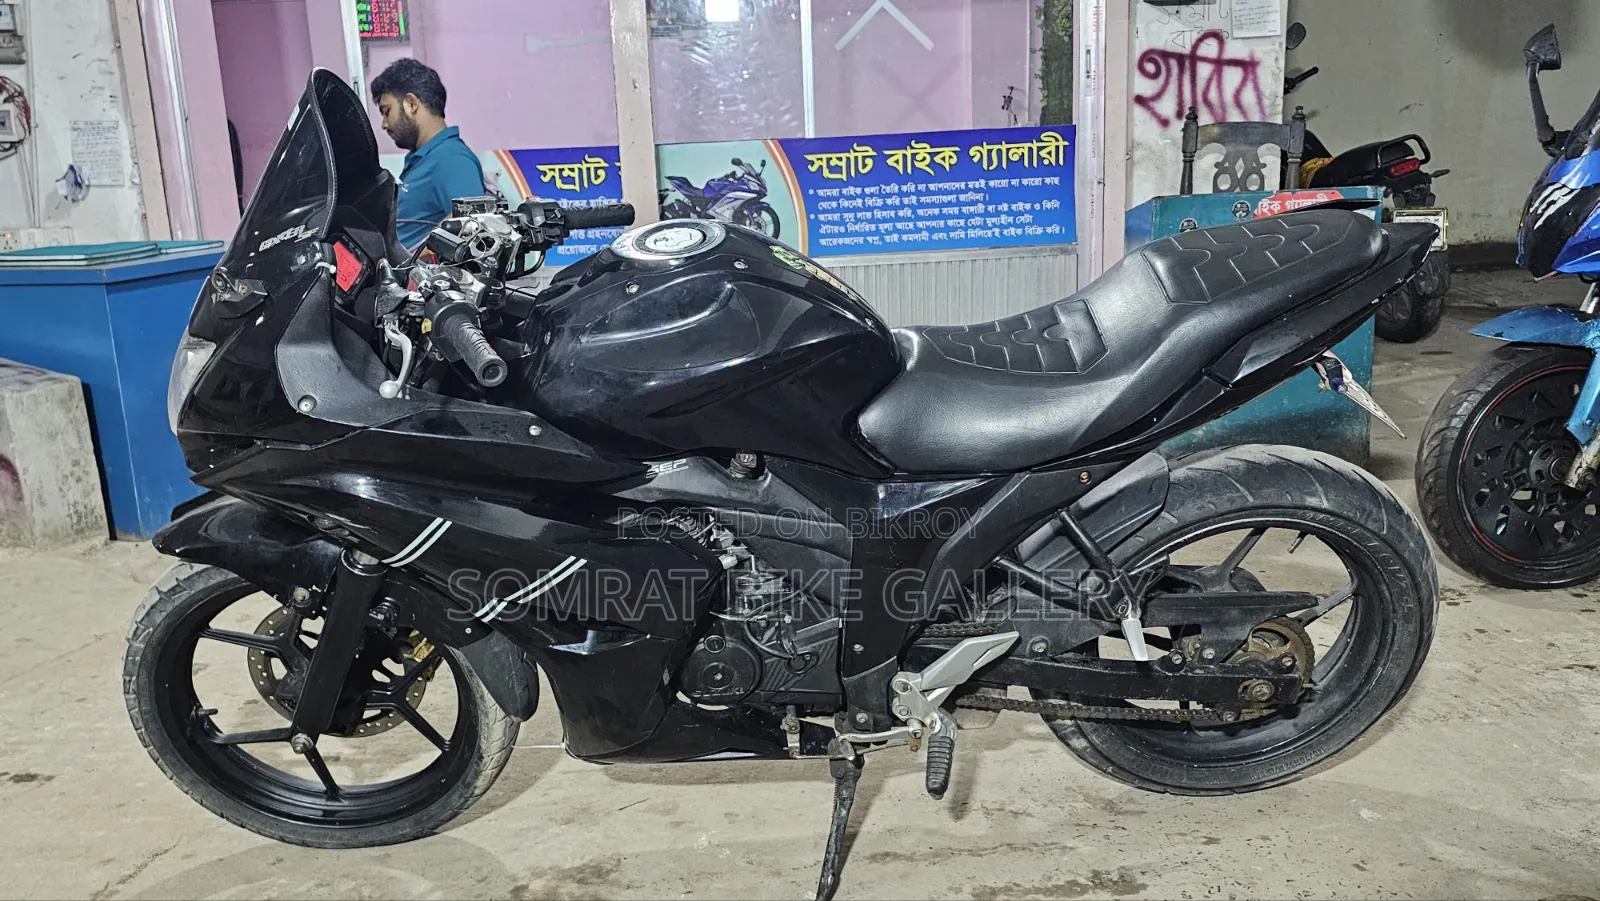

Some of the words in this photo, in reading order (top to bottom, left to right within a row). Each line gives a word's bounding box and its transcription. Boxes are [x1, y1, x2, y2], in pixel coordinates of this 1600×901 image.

[803, 142, 878, 182] সম্রাট
[882, 139, 961, 177] বাইক
[968, 130, 1070, 171] গ্যালারী
[536, 153, 610, 193] সম্রাট
[816, 188, 840, 198] আমরা
[841, 185, 862, 197] বাইক
[880, 182, 899, 194] তৈরি
[901, 181, 915, 193] করি
[917, 183, 926, 193] না
[927, 181, 966, 192] আপনাদের
[988, 179, 1009, 189] কারো
[1010, 178, 1020, 187] না
[1021, 177, 1042, 187] কারো
[817, 201, 838, 210] থেকে
[839, 197, 863, 209] কিনেই
[885, 195, 900, 206] করি
[902, 195, 918, 206] তাই
[817, 212, 841, 223] আমরা
[874, 208, 896, 220] হিসাব
[916, 207, 939, 217] অনেক
[941, 207, 960, 216] সময়
[986, 205, 996, 214] বা
[1010, 201, 1032, 213] বাইক
[1033, 203, 1041, 211] ও
[884, 233, 900, 244] তাই
[931, 231, 947, 241] এবং
[1002, 226, 1023, 238] বাইক
[895, 221, 915, 231] আছে
[916, 219, 945, 231] আপনার
[946, 218, 966, 228] কাছে
